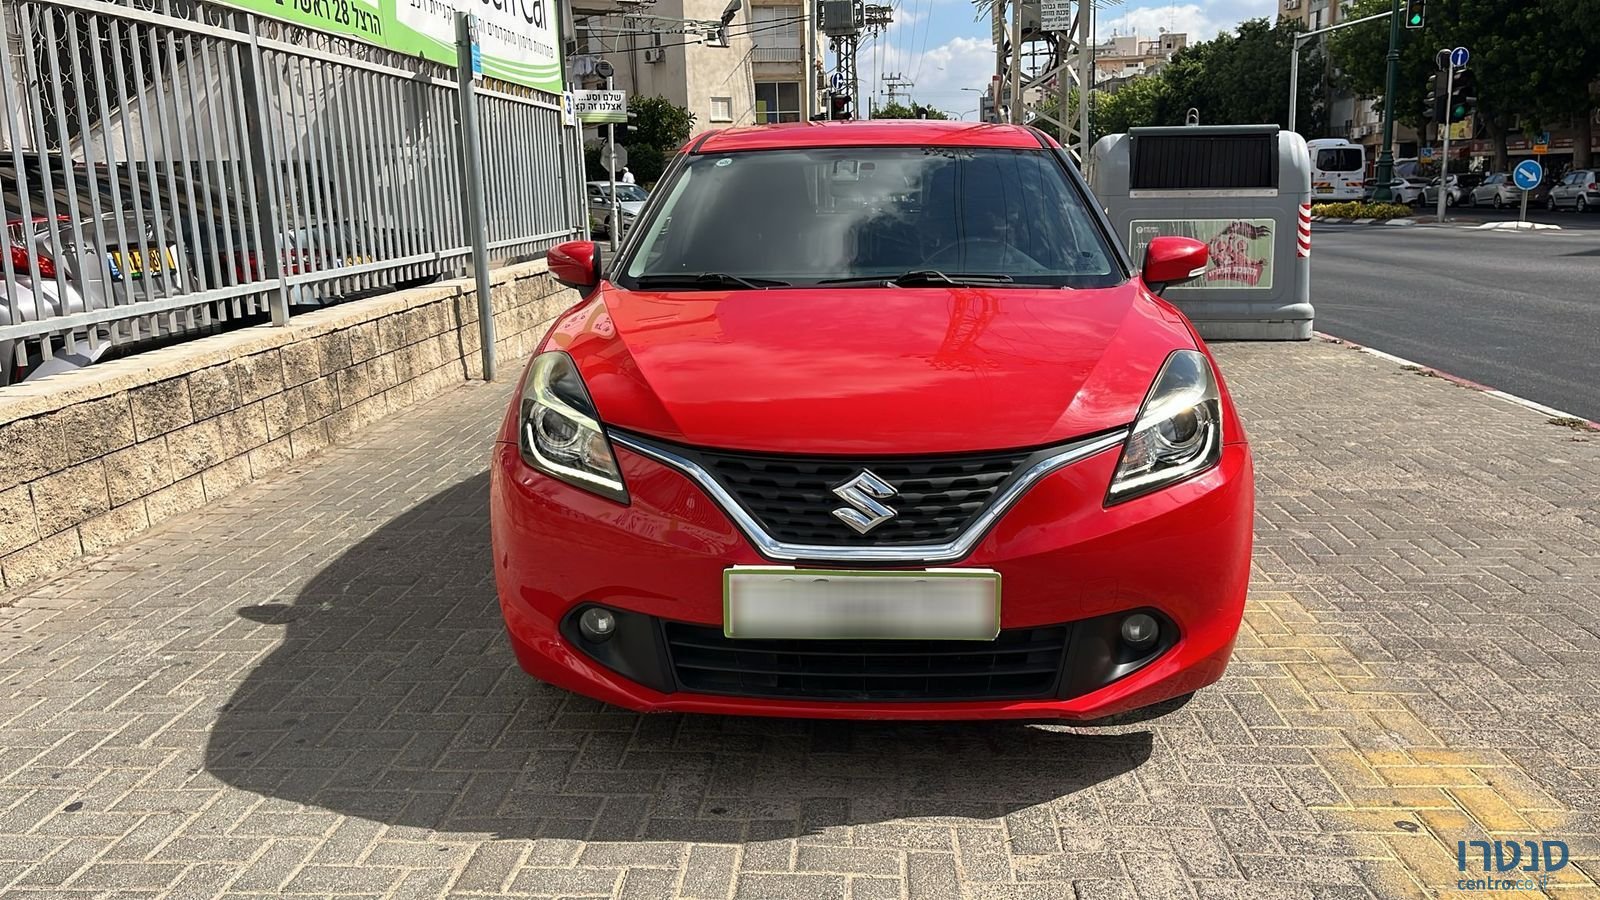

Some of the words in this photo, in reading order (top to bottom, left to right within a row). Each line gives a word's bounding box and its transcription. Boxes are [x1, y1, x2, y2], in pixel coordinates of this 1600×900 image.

[275, 0, 331, 20] ראש
[333, 0, 350, 25] 28
[352, 2, 382, 36] הרצל
[487, 22, 516, 46] מתקדמים
[578, 94, 601, 102] וסע...
[603, 92, 622, 102] שלם
[575, 103, 586, 112] קצ
[599, 102, 622, 111] אצלנו
